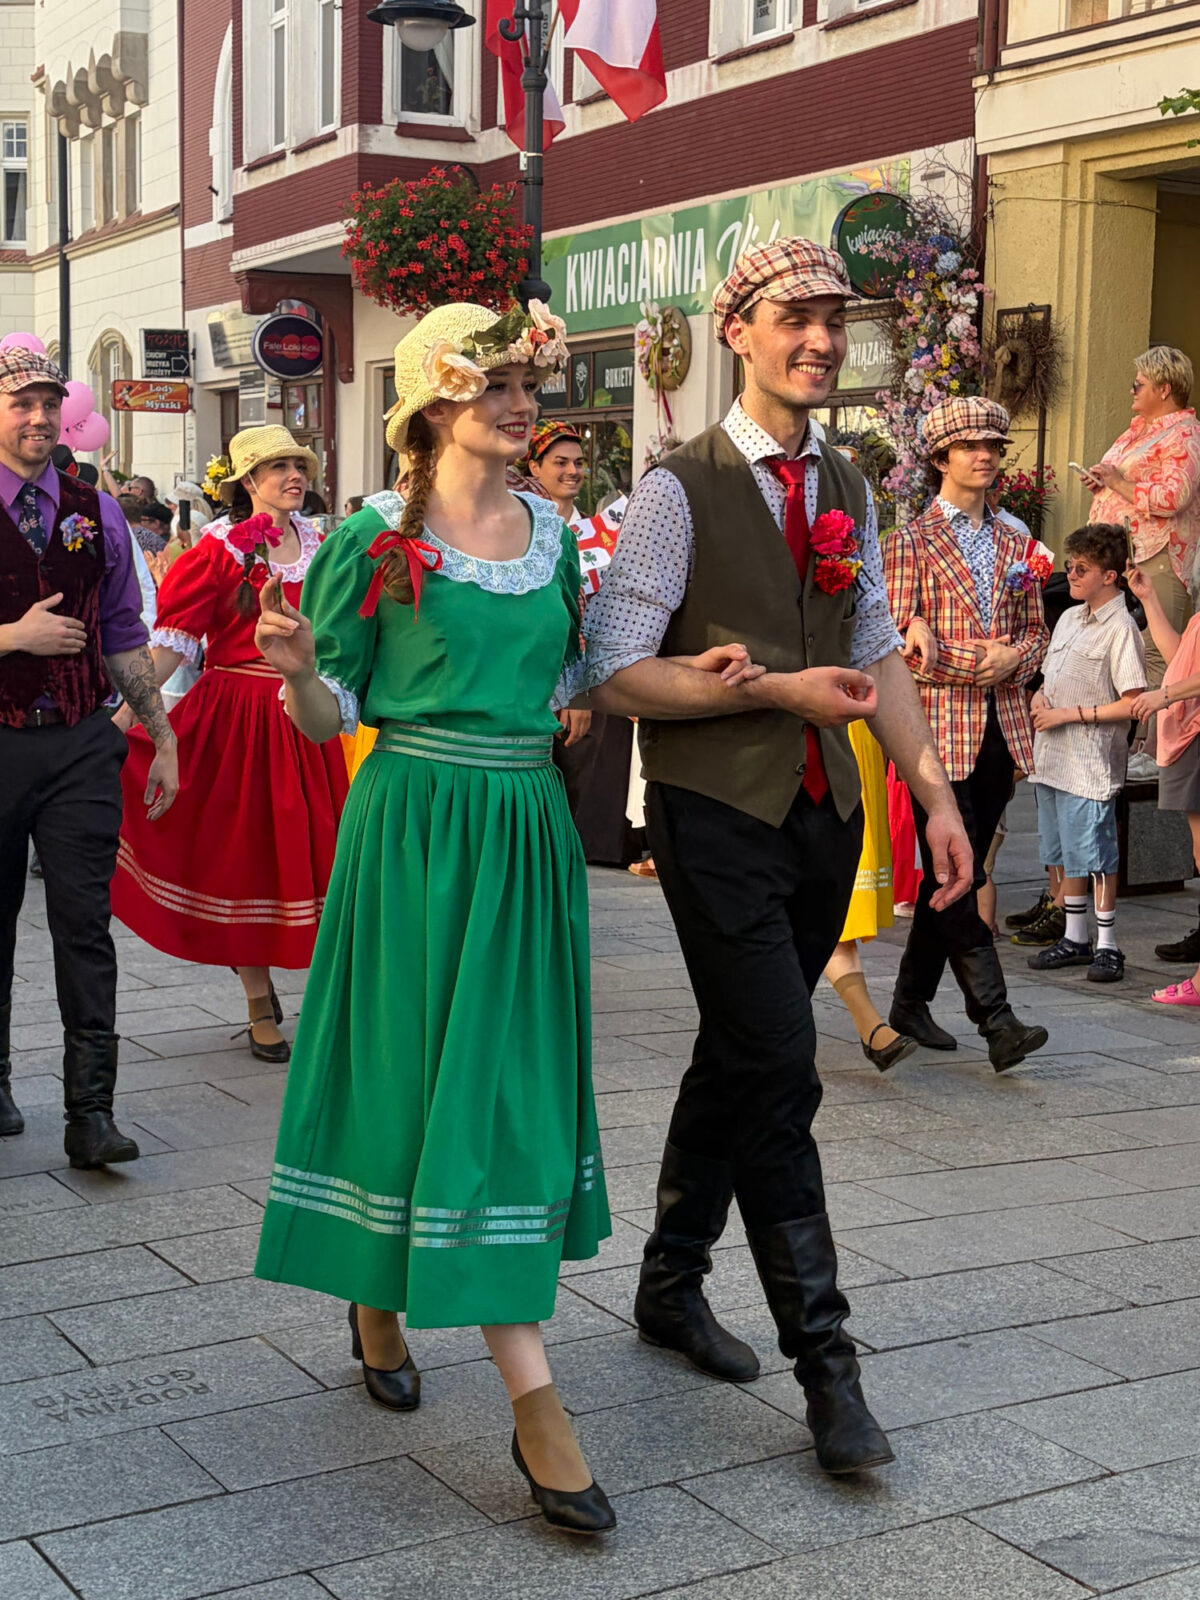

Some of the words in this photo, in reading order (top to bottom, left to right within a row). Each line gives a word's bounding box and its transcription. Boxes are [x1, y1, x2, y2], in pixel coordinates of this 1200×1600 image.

[566, 228, 707, 314] KWIACIARNIA
[149, 383, 173, 393] Lody
[604, 366, 633, 388] BUKIETY
[145, 400, 181, 409] Myszki
[46, 1382, 212, 1422] RODZINA
